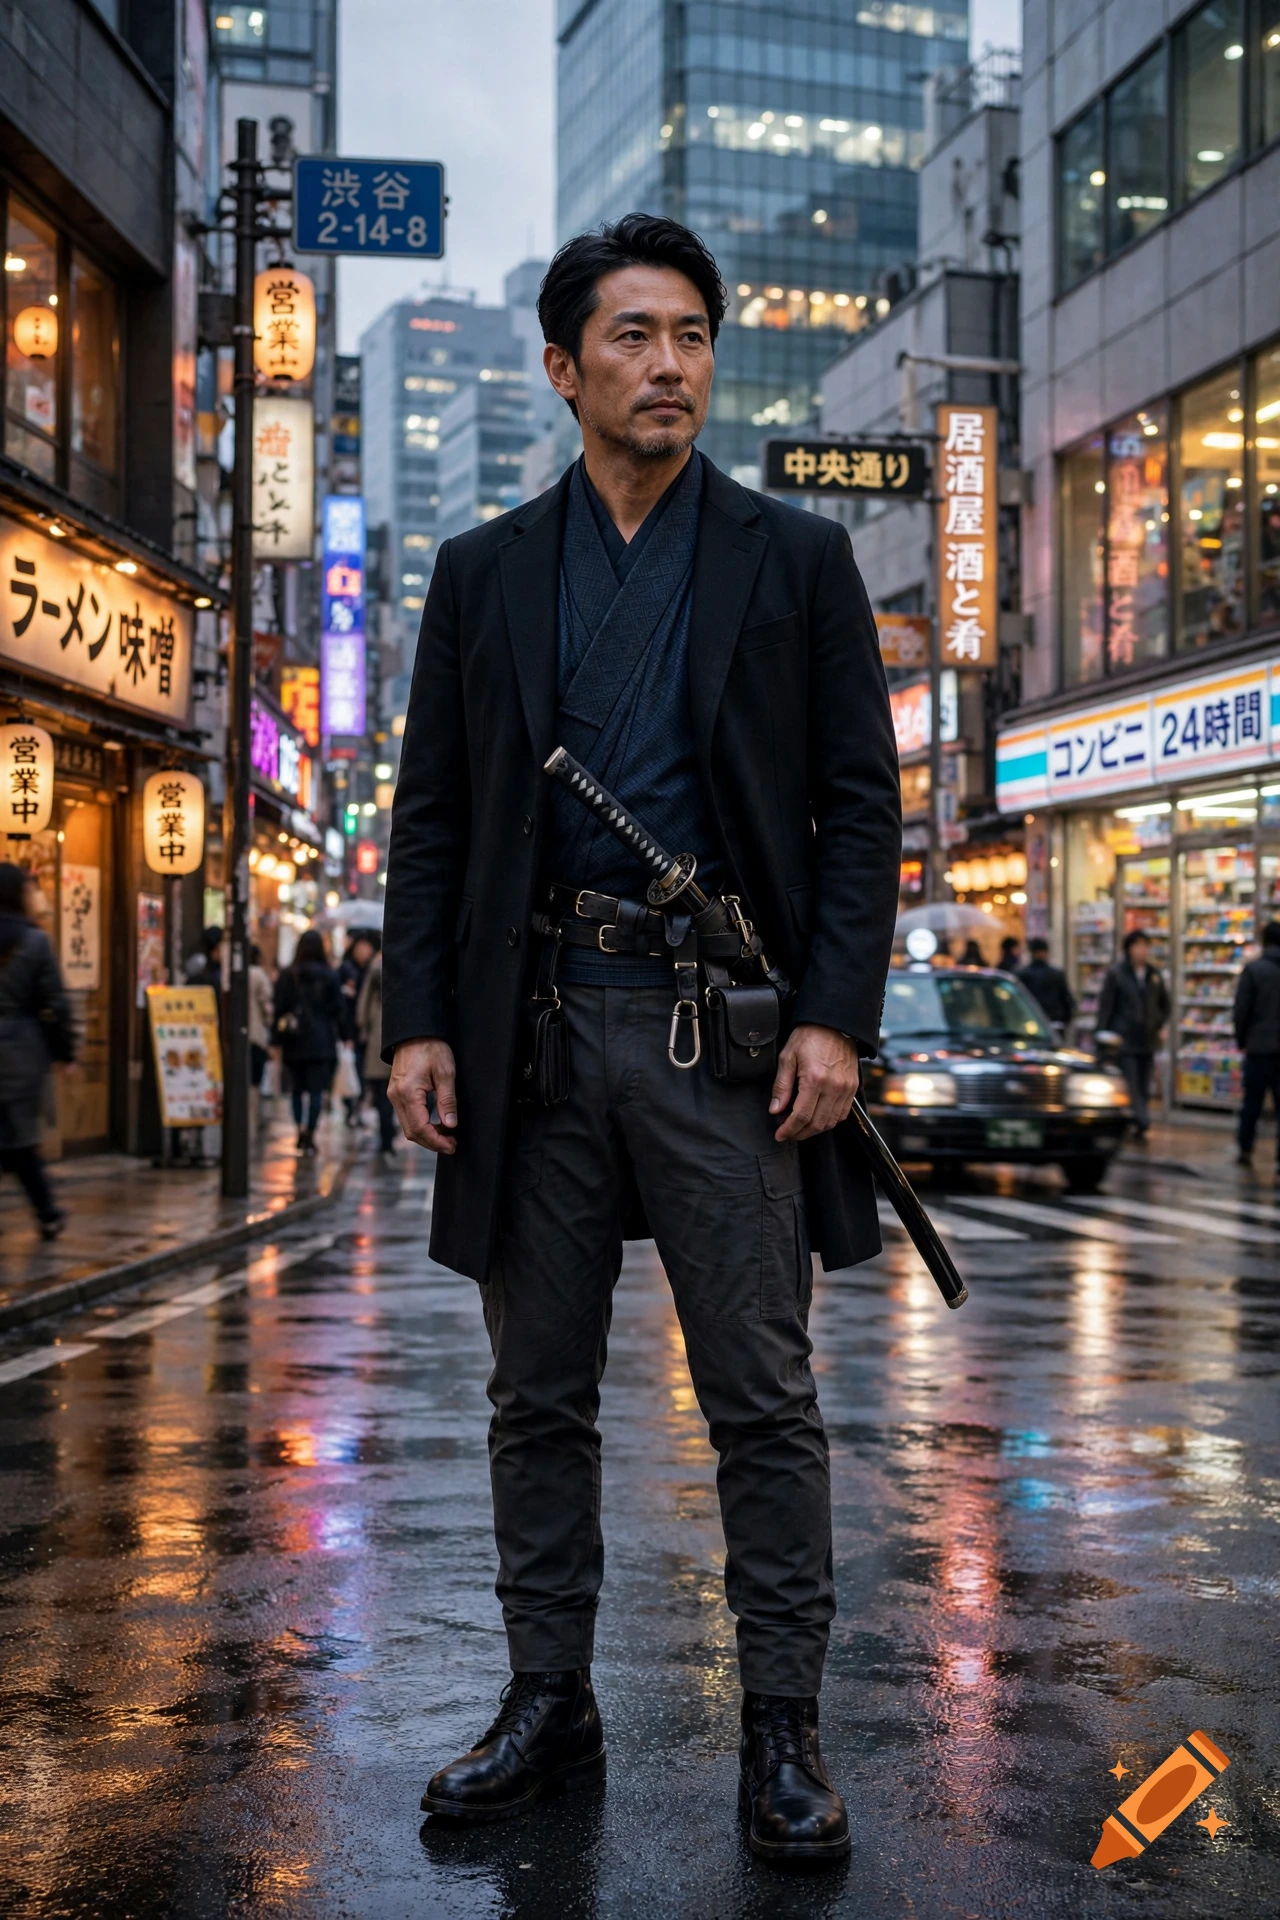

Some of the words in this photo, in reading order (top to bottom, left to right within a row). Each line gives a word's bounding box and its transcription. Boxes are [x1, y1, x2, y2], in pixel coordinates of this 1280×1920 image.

[321, 168, 411, 211] 渋谷
[317, 211, 428, 248] 2-14-8
[783, 447, 911, 489] 中央通り
[1053, 721, 1146, 779] コンビニ
[1161, 690, 1262, 757] 24時間
[9, 736, 40, 824] 営業中
[157, 781, 187, 865] 営業中
